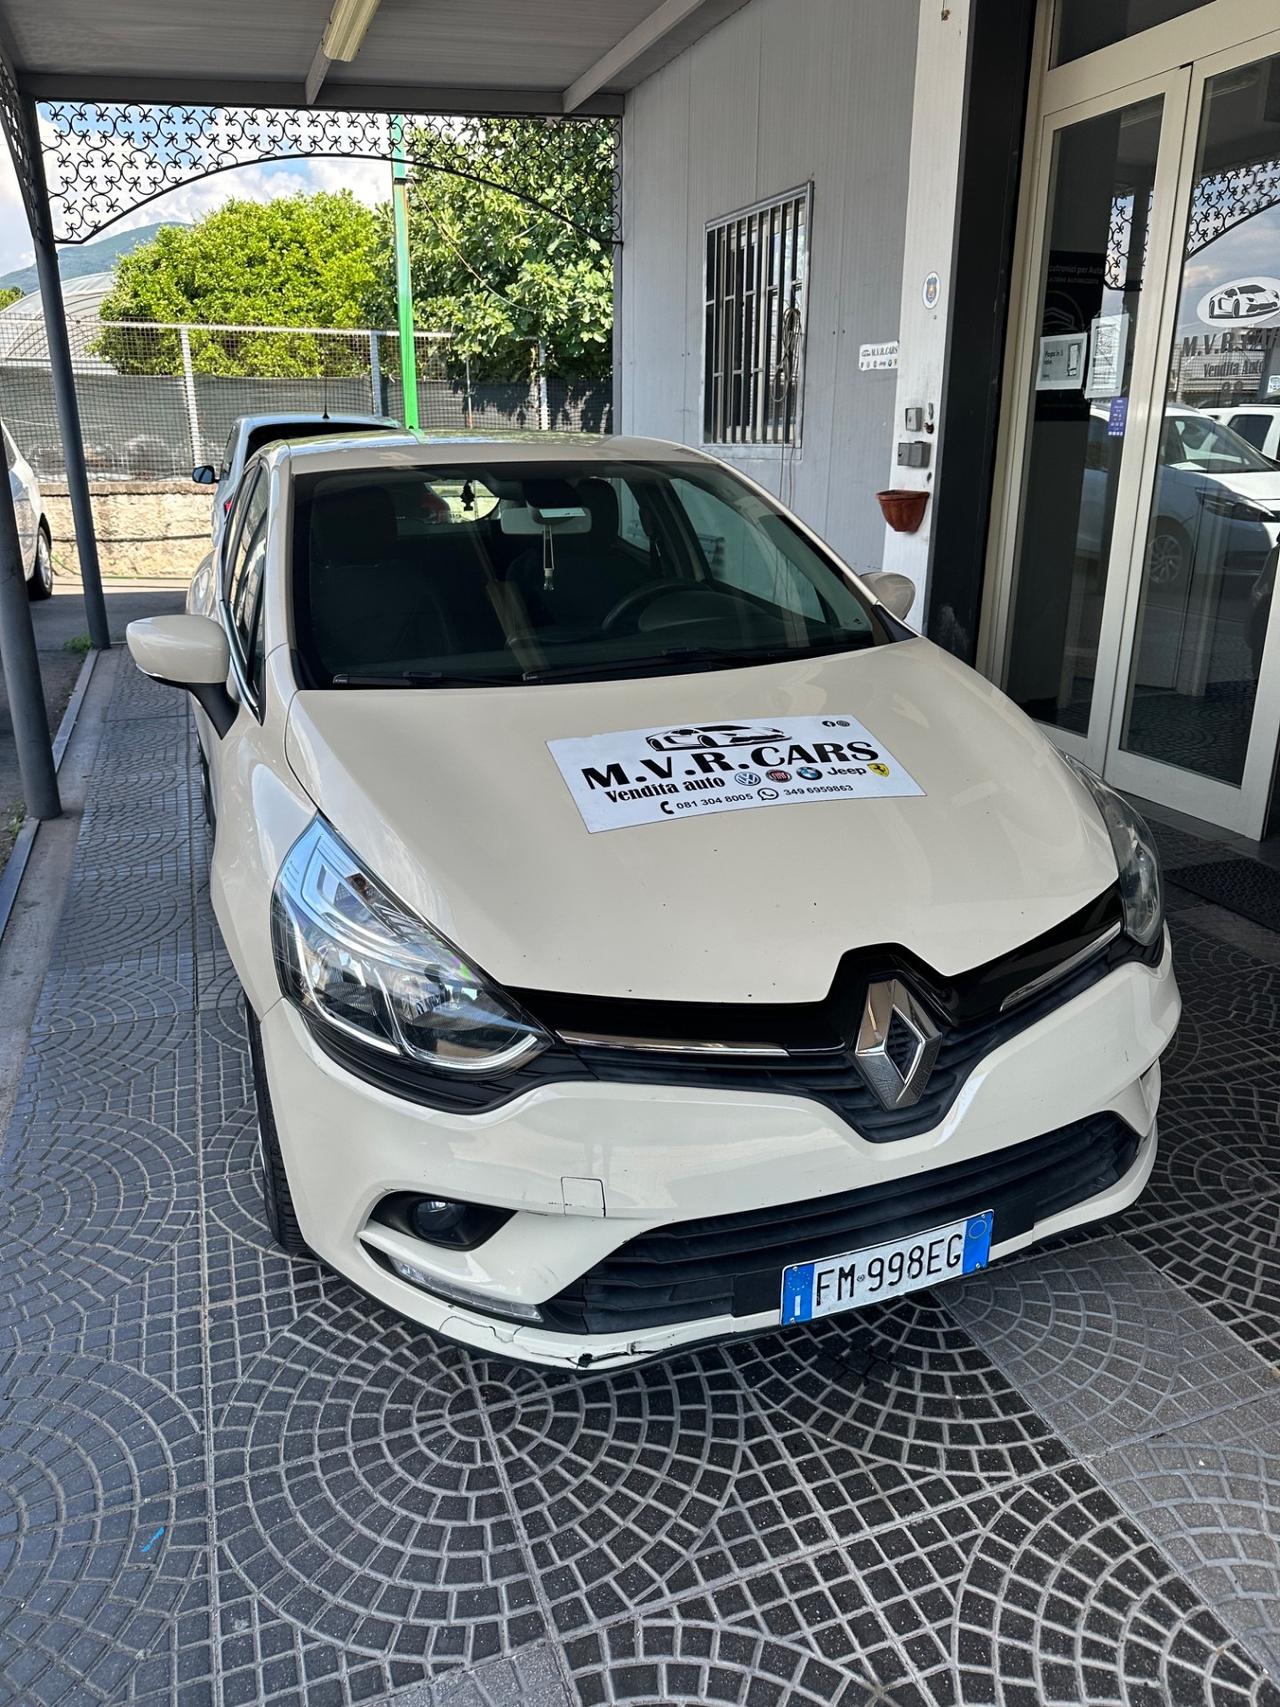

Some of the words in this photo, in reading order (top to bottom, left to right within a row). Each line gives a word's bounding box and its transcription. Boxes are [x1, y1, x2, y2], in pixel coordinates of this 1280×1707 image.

[1204, 361, 1240, 378] Vendita
[826, 764, 867, 777] Jeep
[605, 783, 678, 803] Vendita
[683, 776, 726, 791] auto
[676, 799, 698, 810] 081
[700, 796, 724, 807] 304
[725, 792, 753, 803] 8005
[783, 787, 805, 796] 349
[806, 783, 854, 794] 6959863
[868, 1233, 963, 1293] 998EG
[794, 1295, 801, 1316] I
